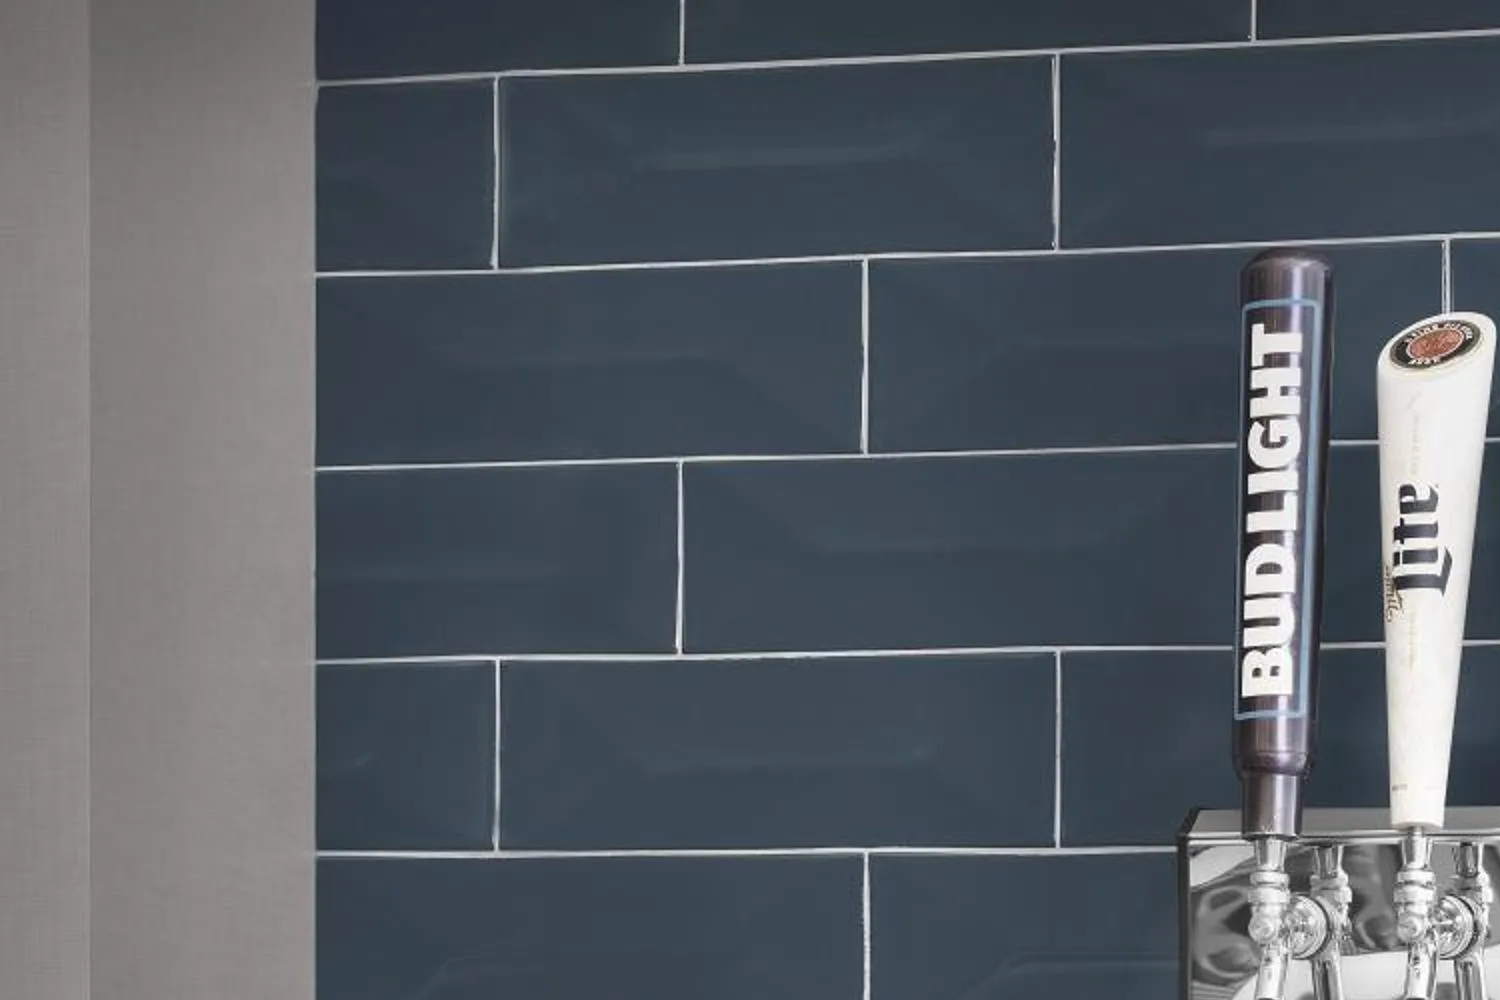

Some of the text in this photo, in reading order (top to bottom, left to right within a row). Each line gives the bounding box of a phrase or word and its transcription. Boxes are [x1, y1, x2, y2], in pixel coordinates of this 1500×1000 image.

[1241, 322, 1303, 697] BUD LIGHT
[1393, 483, 1453, 597] Lite
